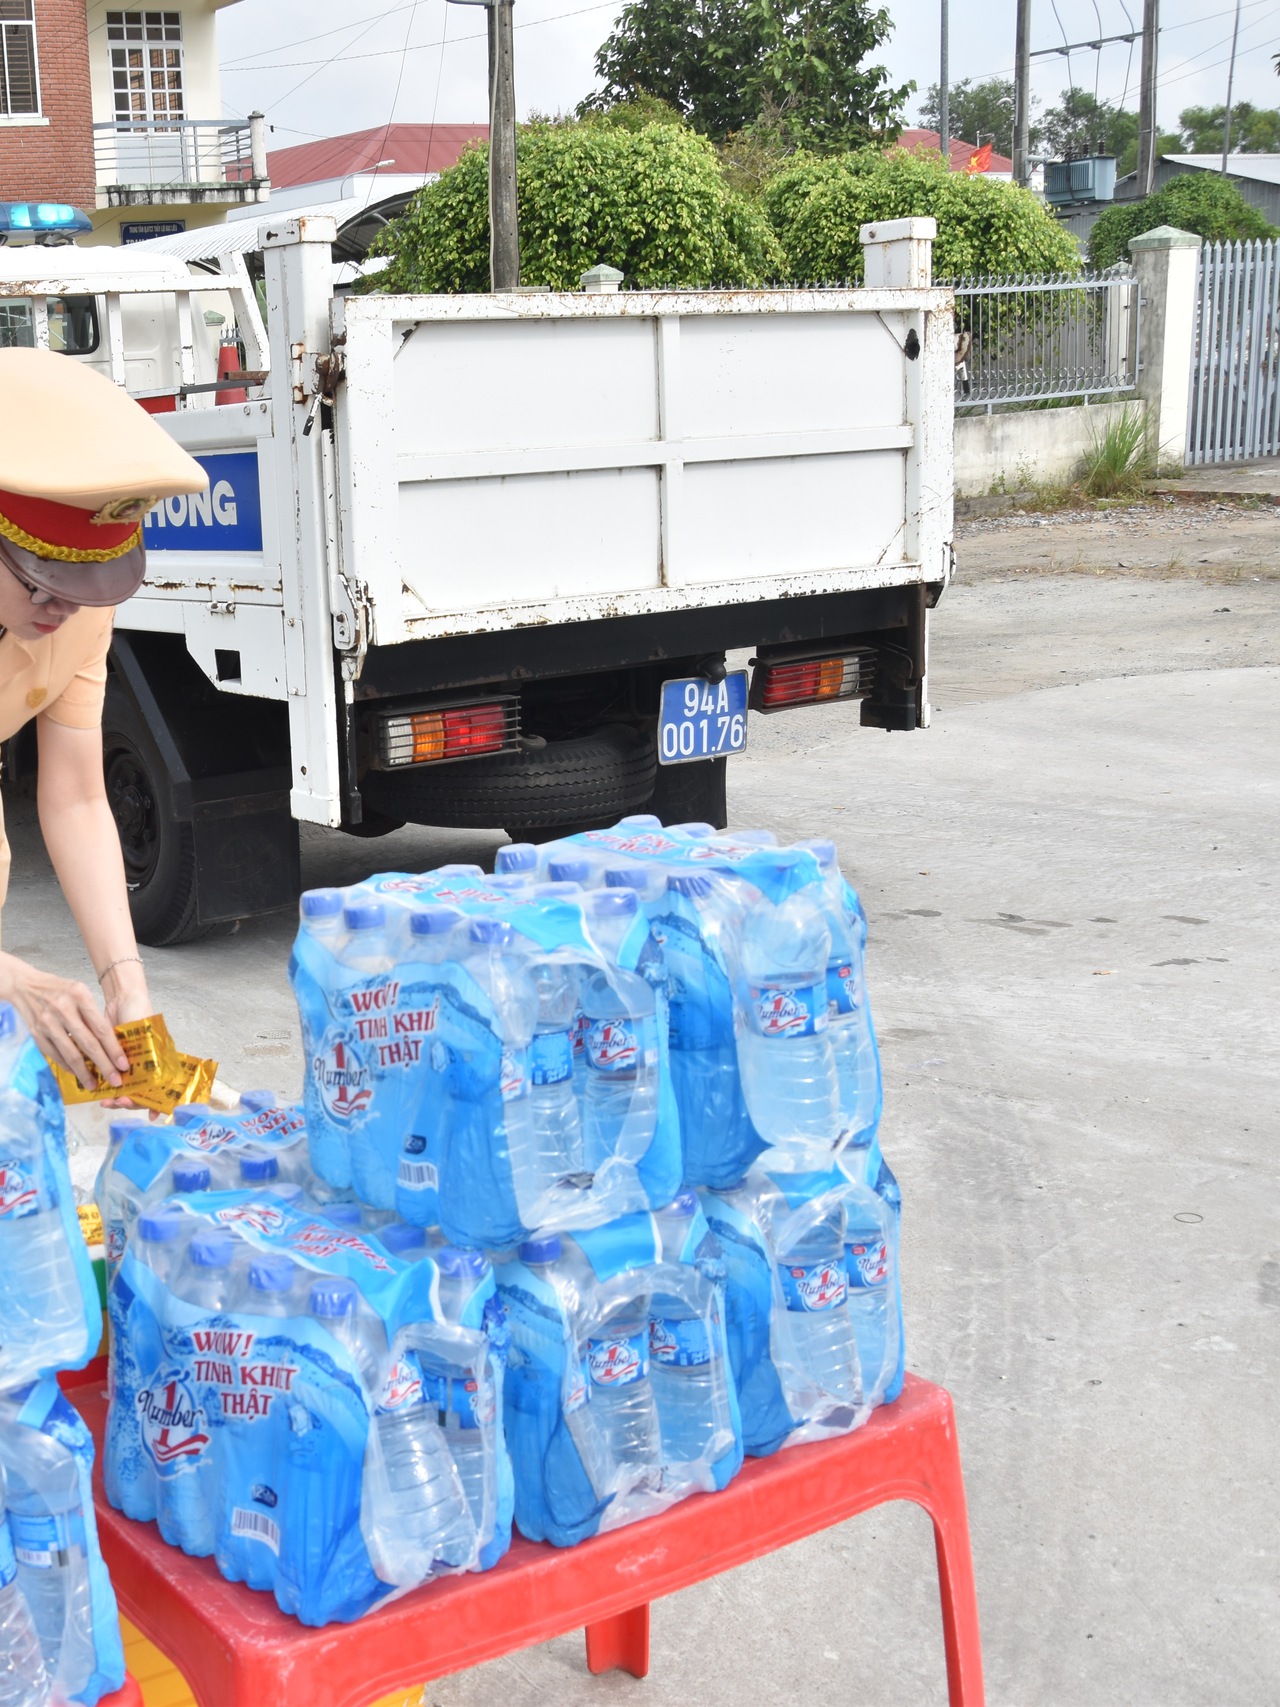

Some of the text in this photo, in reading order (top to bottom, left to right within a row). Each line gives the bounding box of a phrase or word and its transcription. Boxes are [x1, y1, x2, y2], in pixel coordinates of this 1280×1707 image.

[683, 679, 728, 717] 94A
[663, 714, 744, 758] 001.76
[379, 1035, 422, 1068] THẬT
[314, 1042, 367, 1102] Number 1
[818, 1270, 830, 1301] 1
[193, 1331, 253, 1357] WOW!
[194, 1361, 233, 1385] TINH
[138, 1380, 203, 1448] Number 1
[221, 1388, 272, 1420] THẬT
